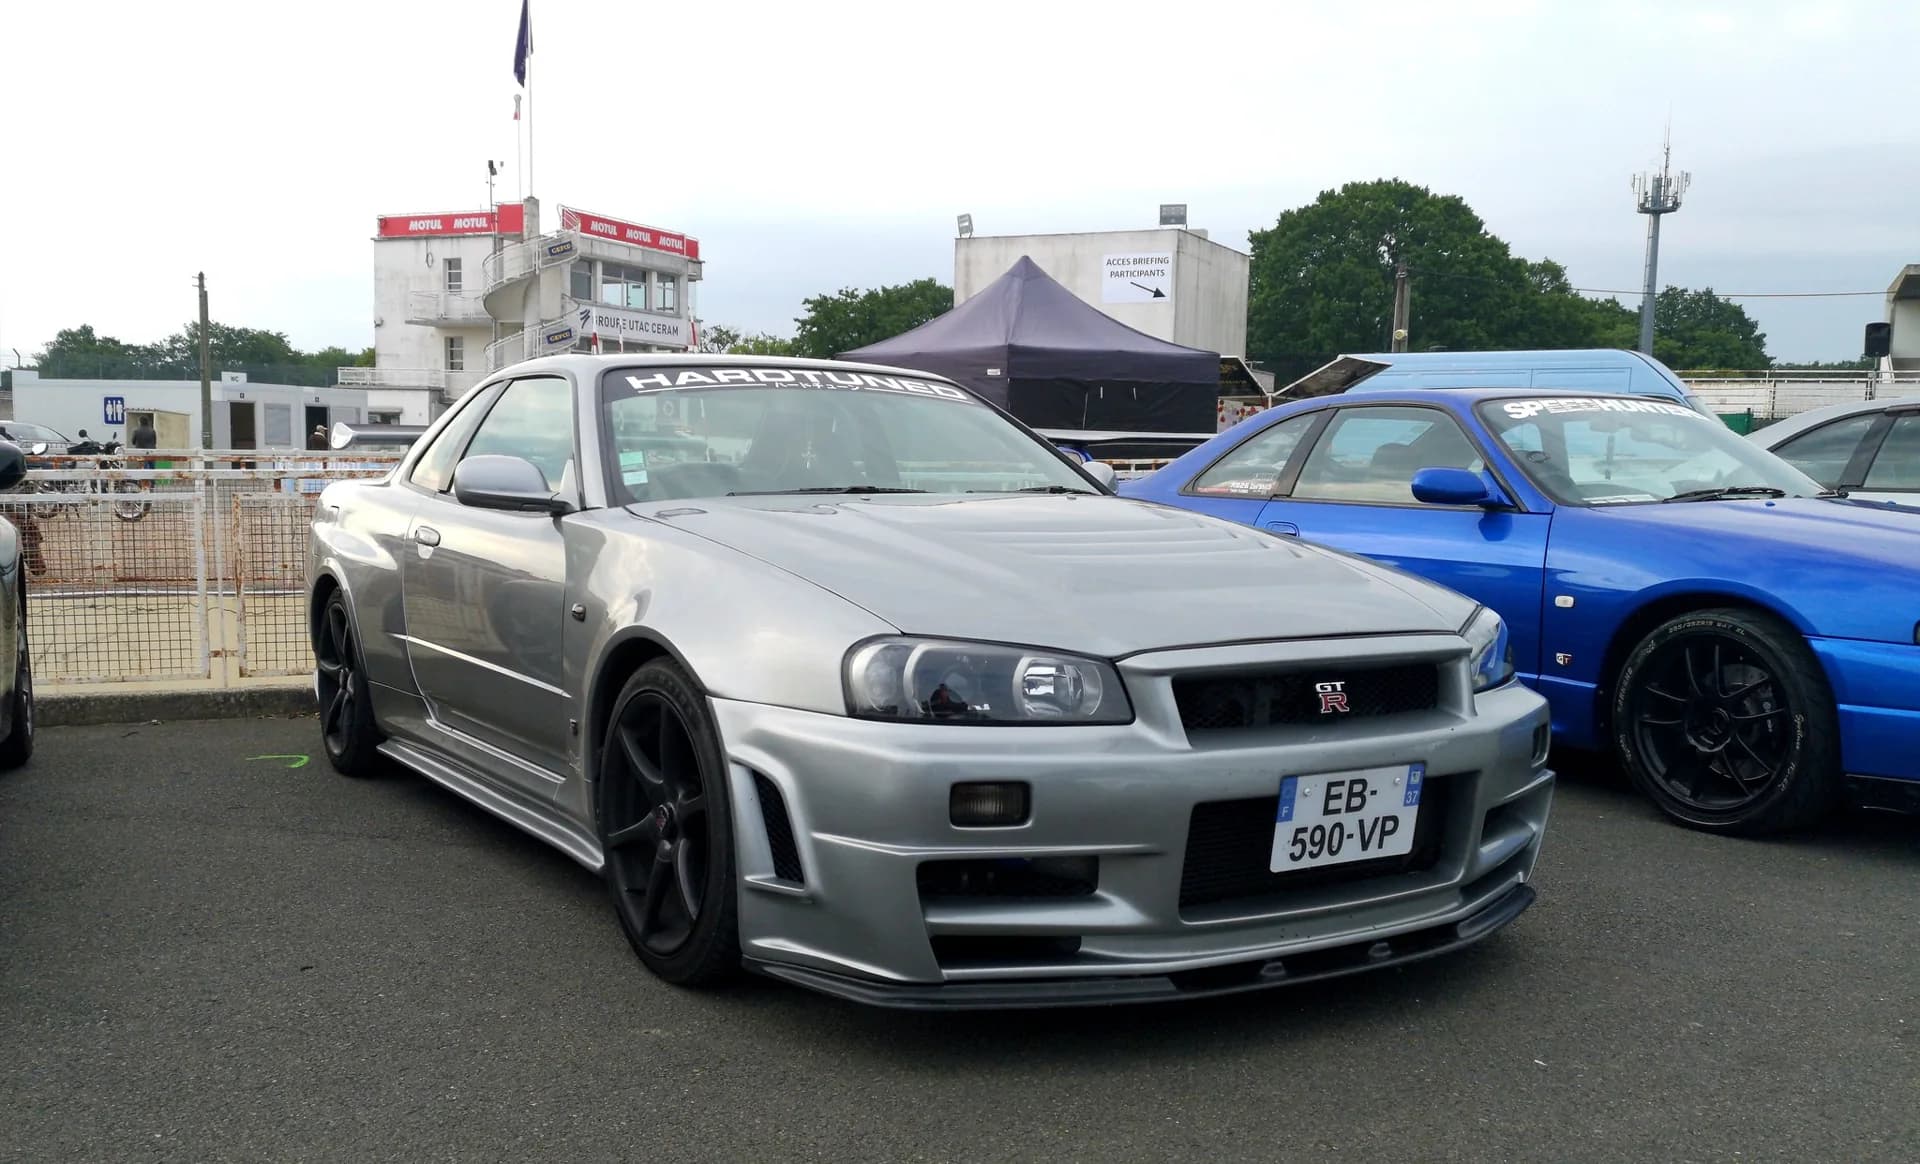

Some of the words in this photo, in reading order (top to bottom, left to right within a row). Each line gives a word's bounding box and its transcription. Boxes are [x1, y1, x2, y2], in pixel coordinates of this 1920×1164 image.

[409, 219, 443, 231] MOTUL
[453, 217, 488, 229] MOTUL
[590, 221, 618, 236] MOTUL
[625, 228, 652, 243] MOTUL
[659, 235, 683, 250] MOTUL
[1106, 258, 1131, 266] ACCES
[1132, 257, 1169, 265] BRIEFING
[1110, 269, 1165, 278] PARTICIPANTS
[595, 316, 627, 330] ROUPE
[628, 319, 650, 333] UTAC
[651, 322, 679, 336] CERAM
[624, 368, 969, 400] HARDTUNED
[1322, 778, 1378, 816] EB-
[1406, 790, 1418, 804] 37
[1281, 806, 1290, 818] F
[1288, 814, 1400, 862] 590-VP
